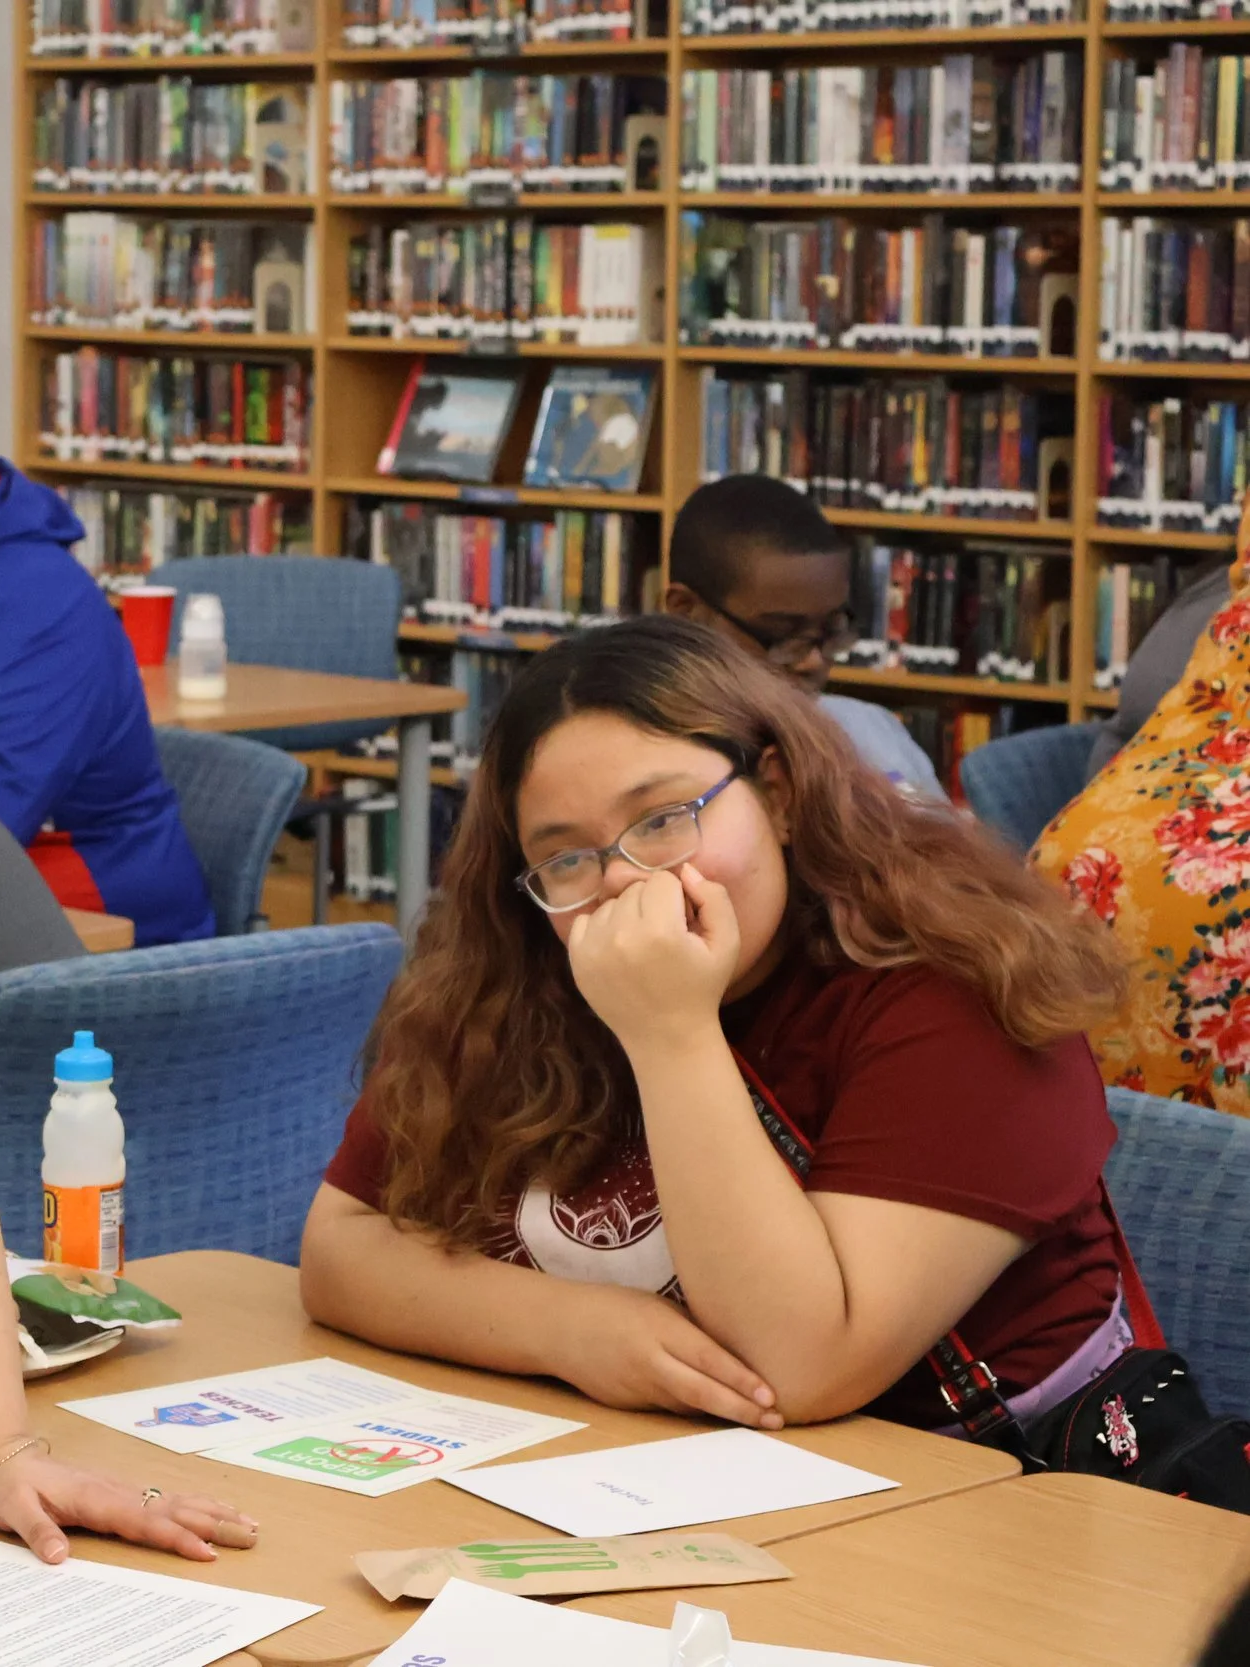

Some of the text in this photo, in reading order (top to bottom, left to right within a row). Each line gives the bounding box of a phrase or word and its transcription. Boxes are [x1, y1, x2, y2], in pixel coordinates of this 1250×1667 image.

[198, 1392, 284, 1422] TEACHER
[353, 1422, 467, 1449] STUDENT
[269, 1450, 378, 1477] REPORT
[596, 1482, 654, 1506] Teacher
